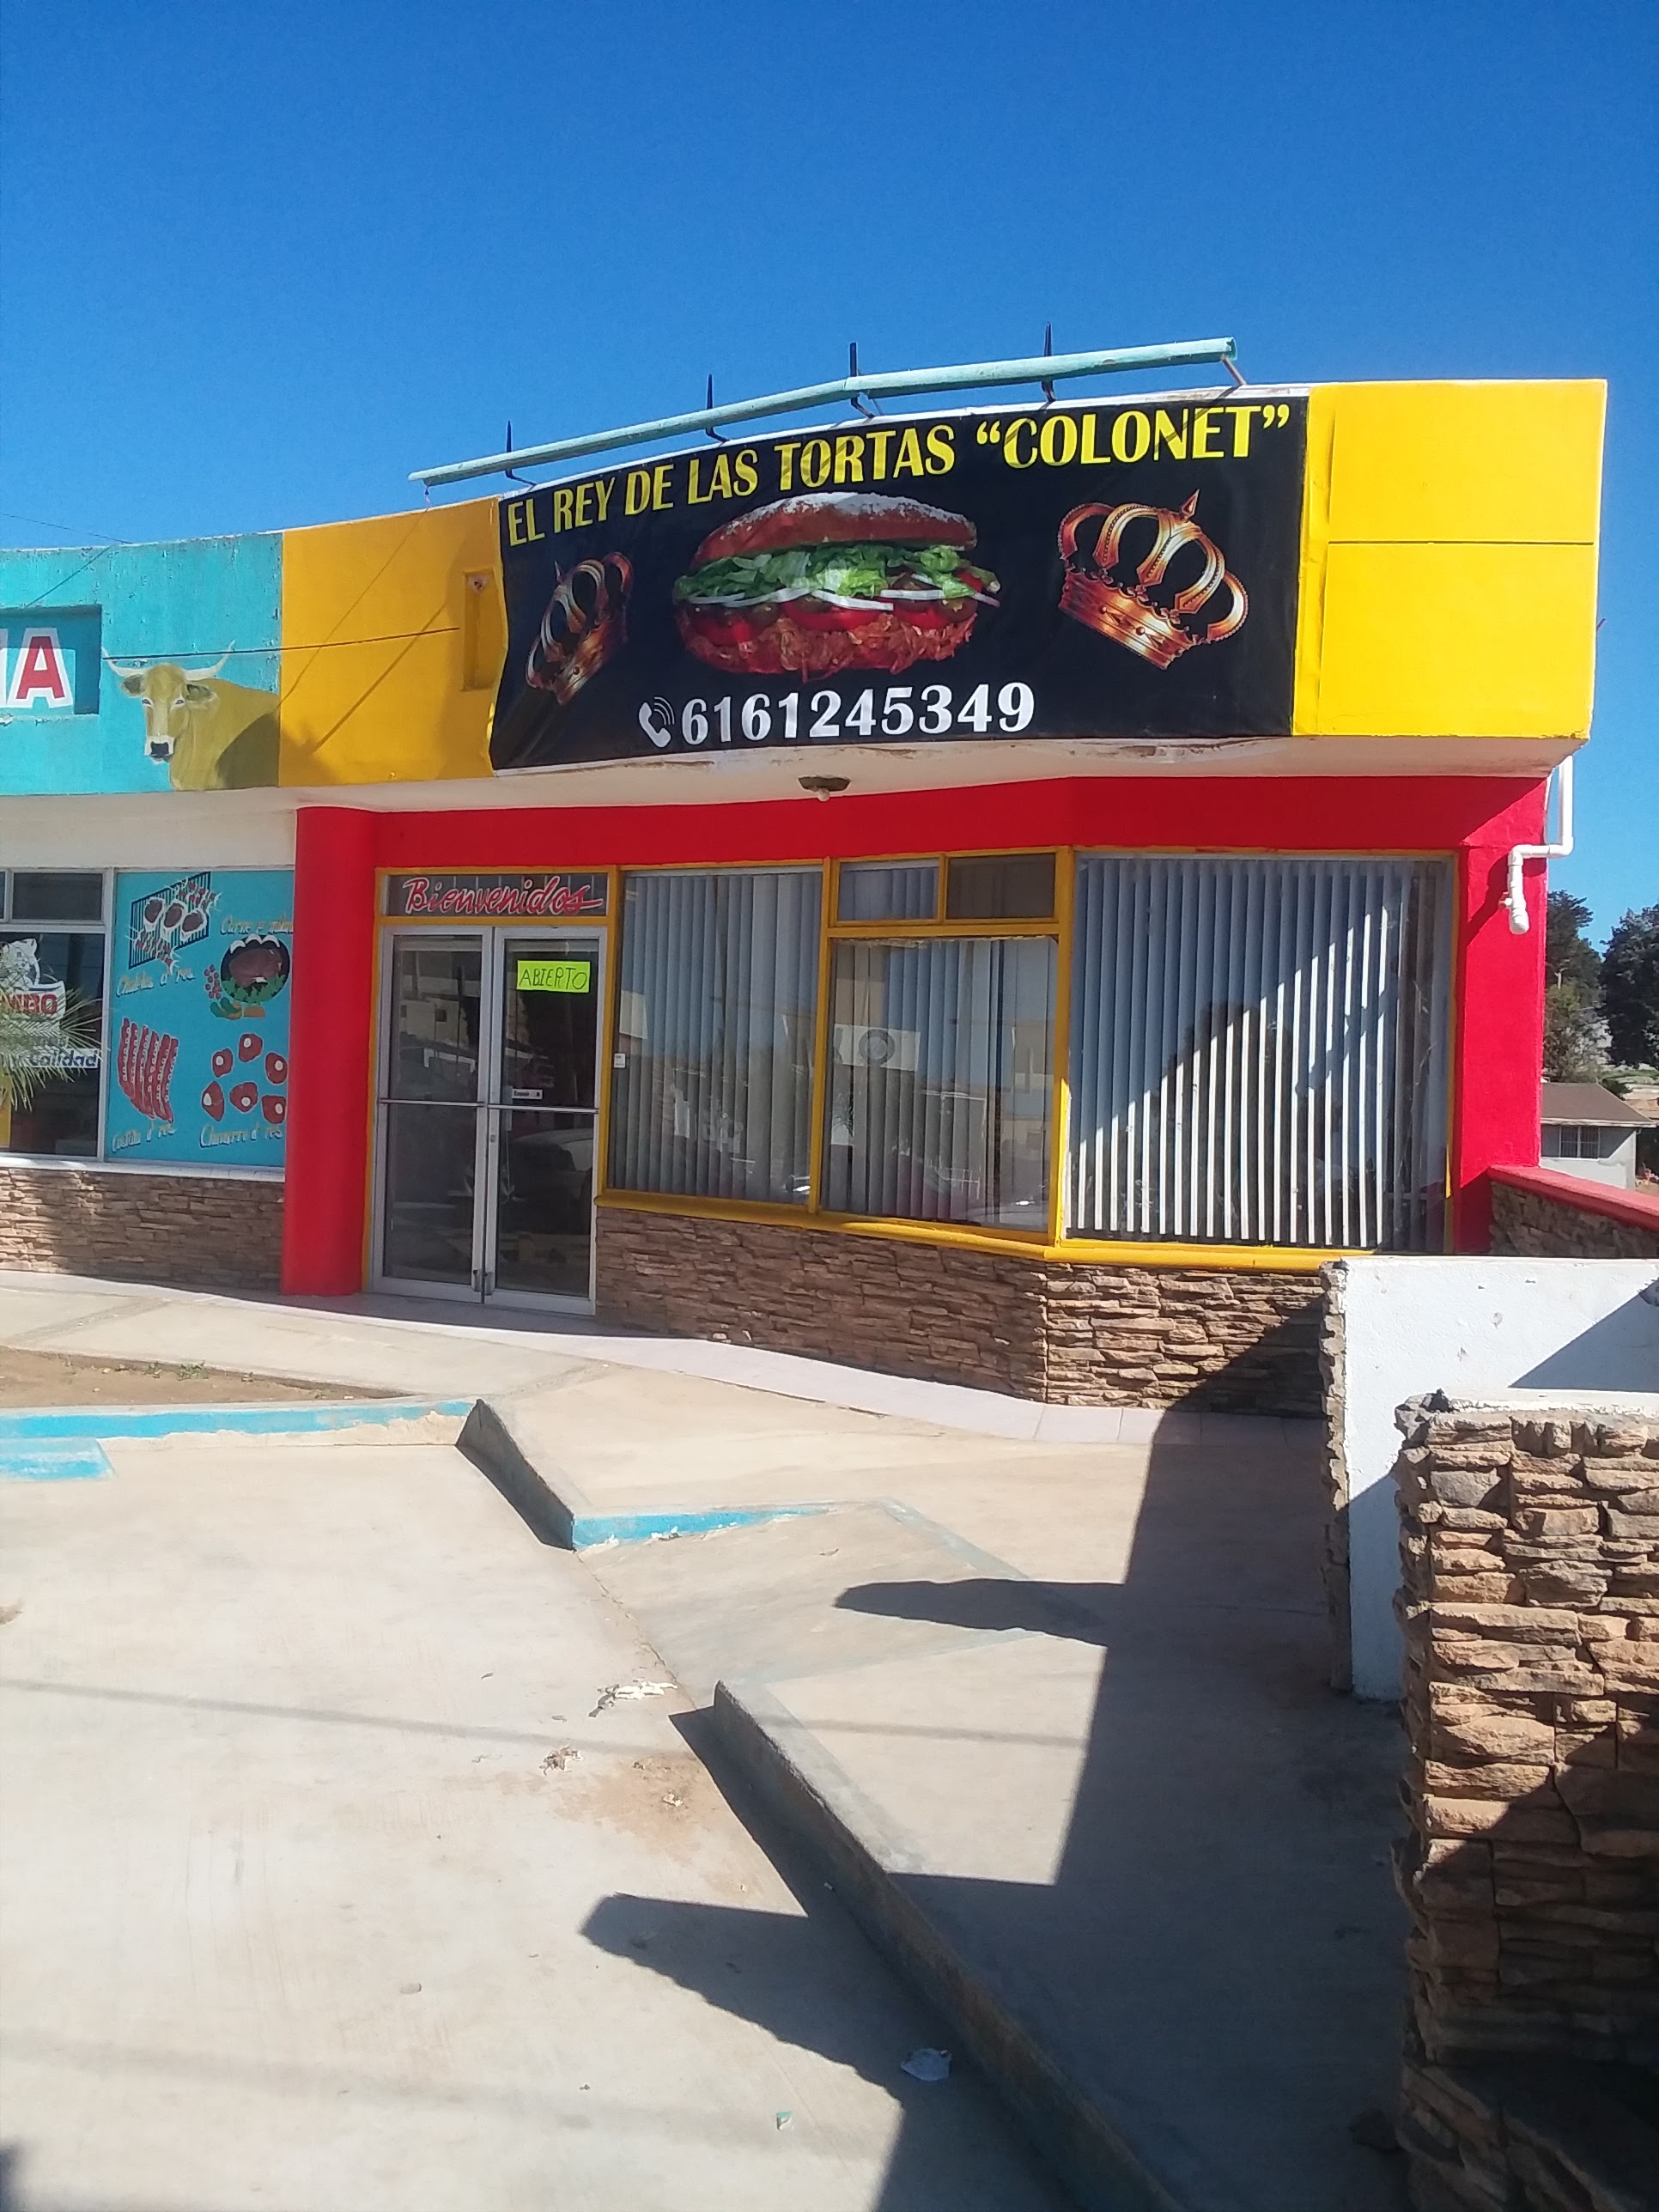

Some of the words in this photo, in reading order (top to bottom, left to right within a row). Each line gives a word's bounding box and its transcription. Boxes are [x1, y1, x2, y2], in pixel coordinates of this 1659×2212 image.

[508, 501, 545, 547] EL
[552, 476, 616, 533] REY
[624, 465, 674, 515] DE
[688, 449, 758, 505] LAS
[774, 424, 956, 491] TORTAS
[682, 681, 1036, 745] 6161245349
[403, 875, 604, 915] Bienvenidos
[519, 967, 587, 990] ABIERTO
